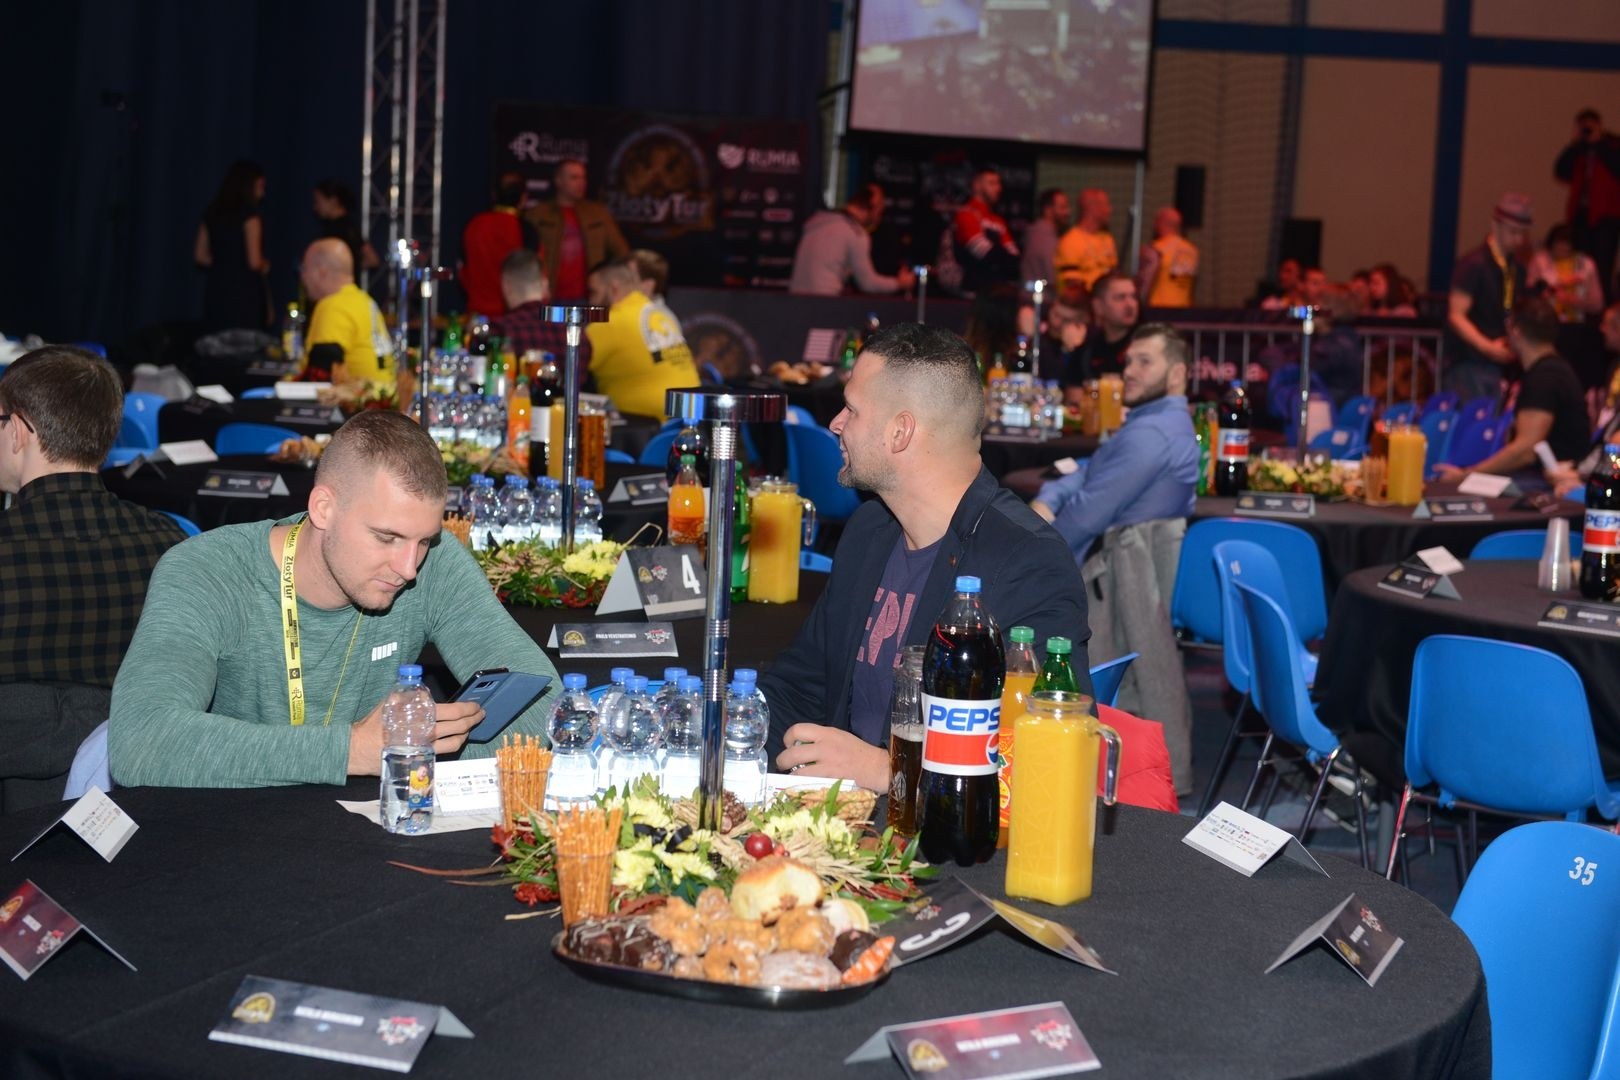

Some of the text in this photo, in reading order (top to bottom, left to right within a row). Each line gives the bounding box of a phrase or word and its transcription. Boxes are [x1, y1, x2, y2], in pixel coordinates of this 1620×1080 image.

[746, 147, 800, 166] RUMIA
[681, 553, 701, 595] 4
[1568, 856, 1598, 886] 35
[899, 911, 972, 952] 3
